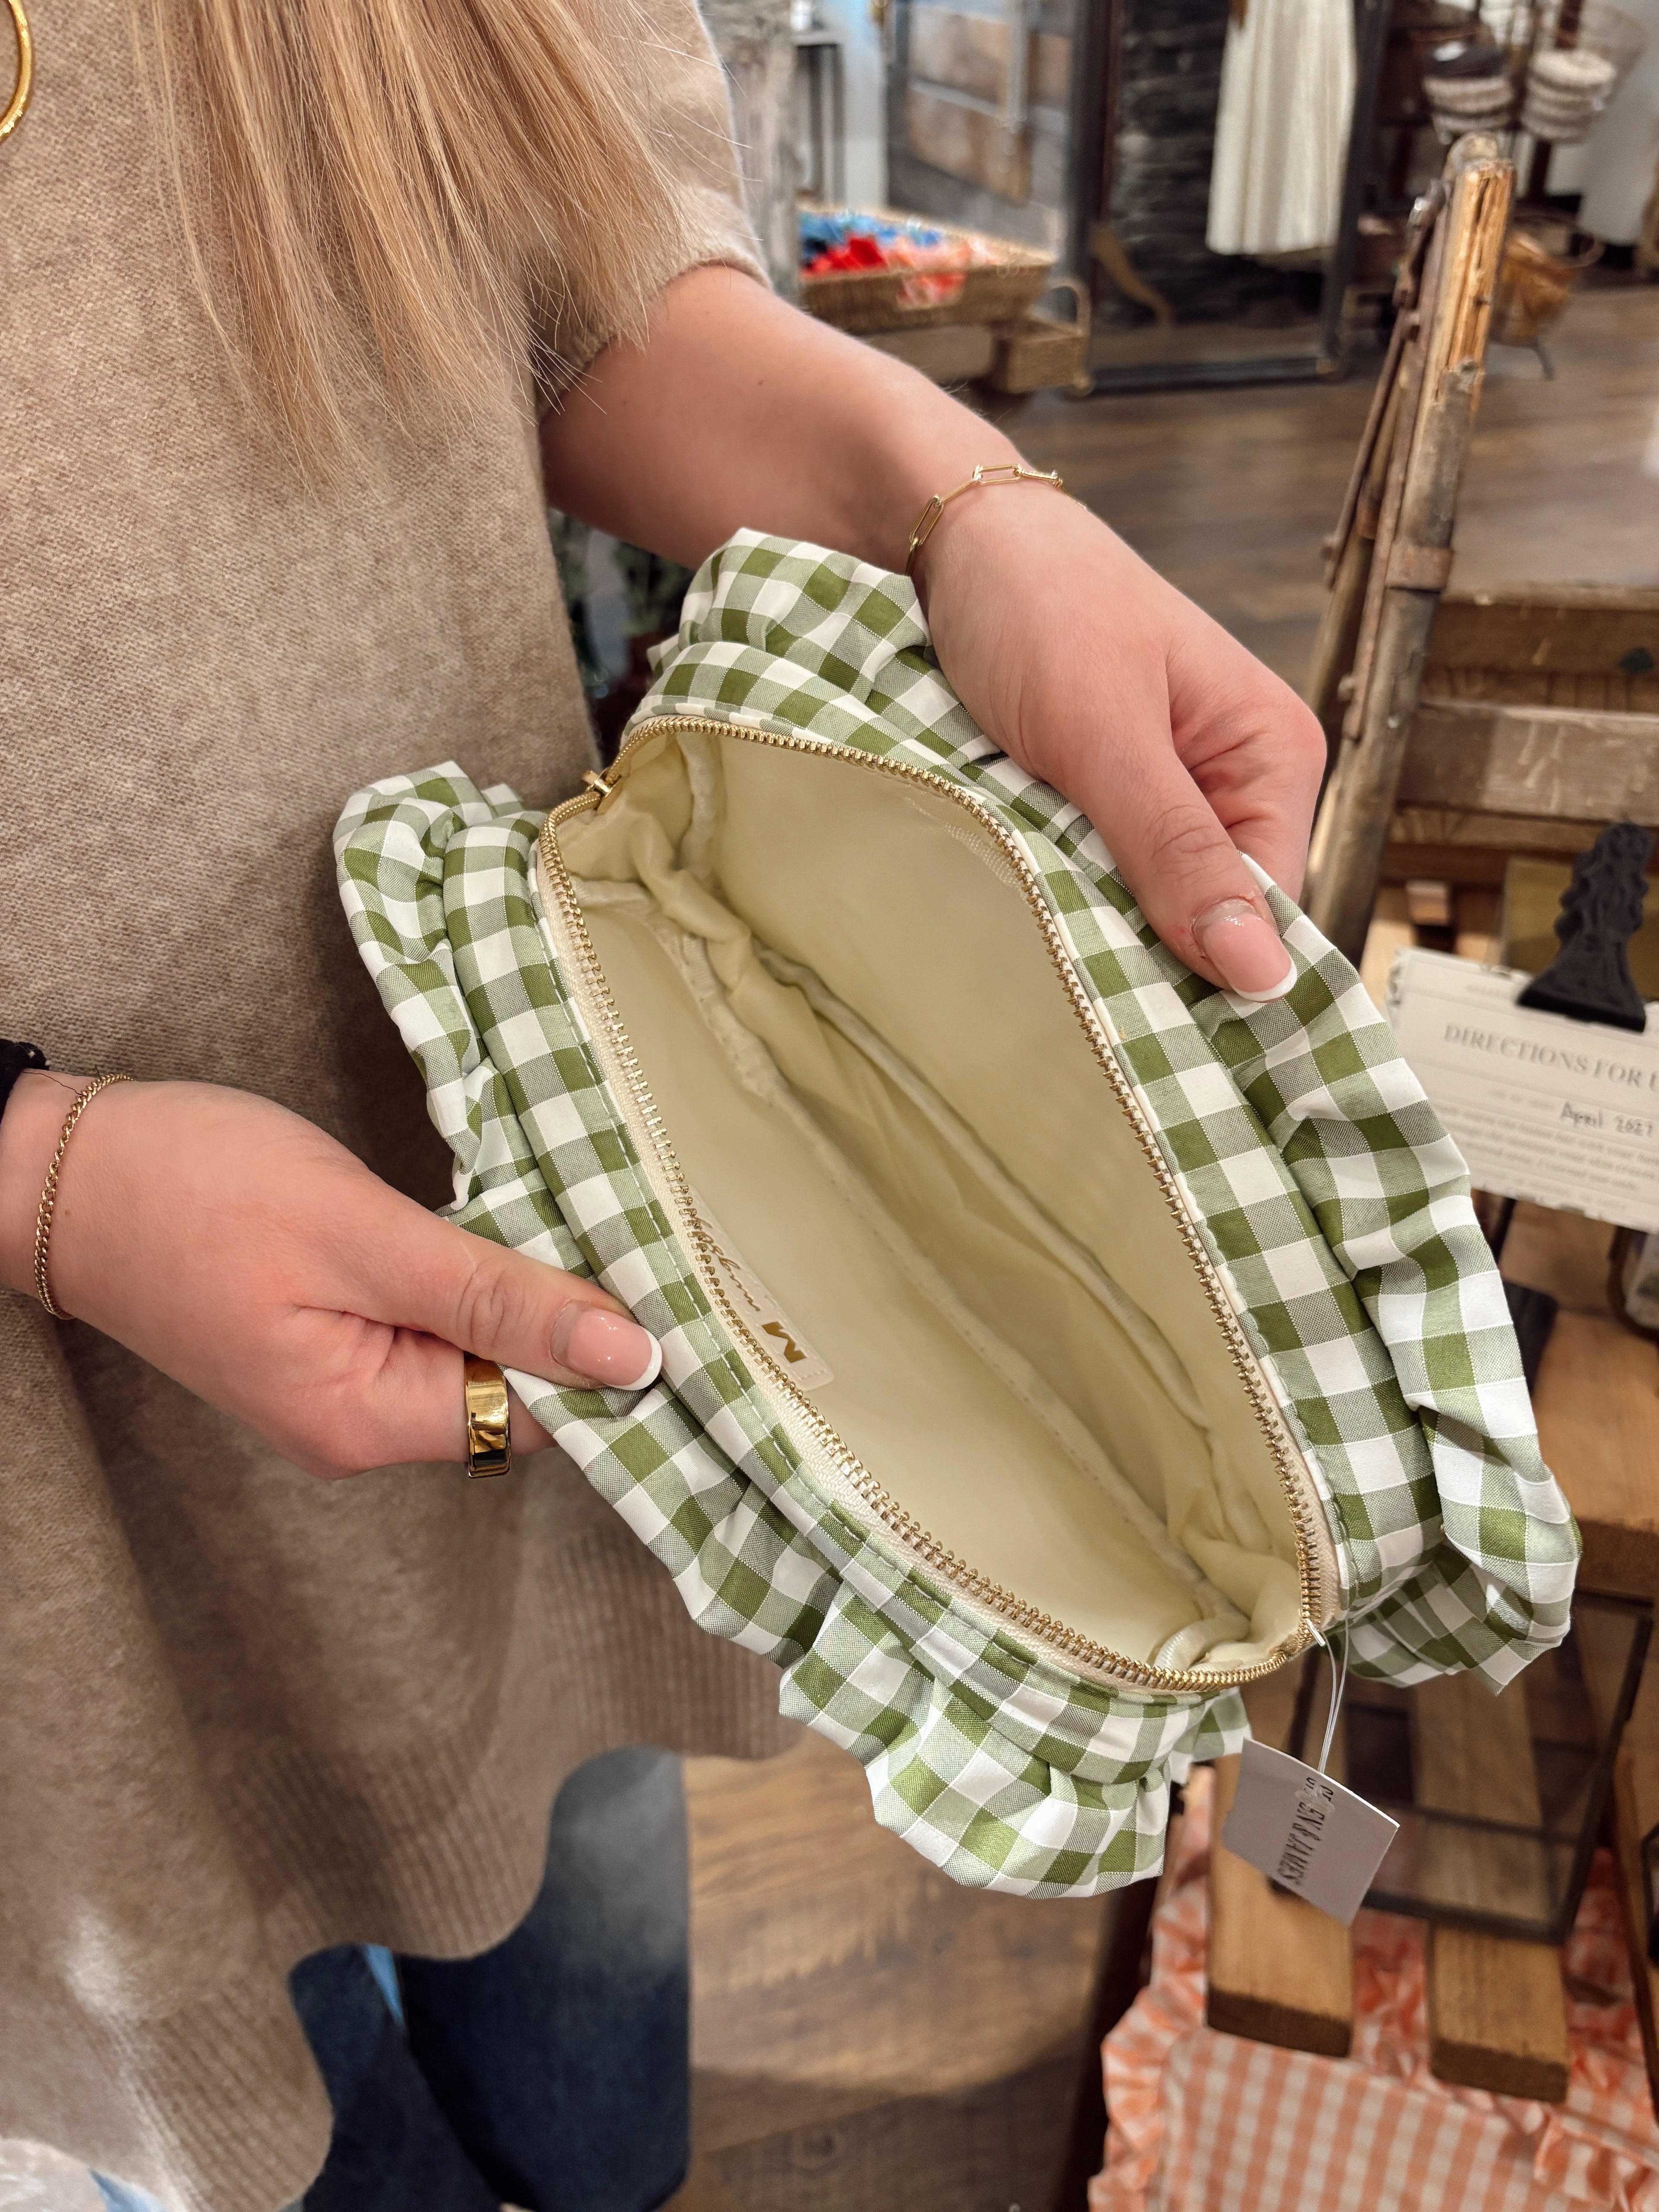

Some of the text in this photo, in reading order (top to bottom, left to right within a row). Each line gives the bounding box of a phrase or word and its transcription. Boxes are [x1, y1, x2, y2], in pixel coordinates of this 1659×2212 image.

[1444, 1022, 1588, 1074] DIRECTIONS
[1592, 1057, 1642, 1088] FOR
[1560, 1101, 1603, 1129] April
